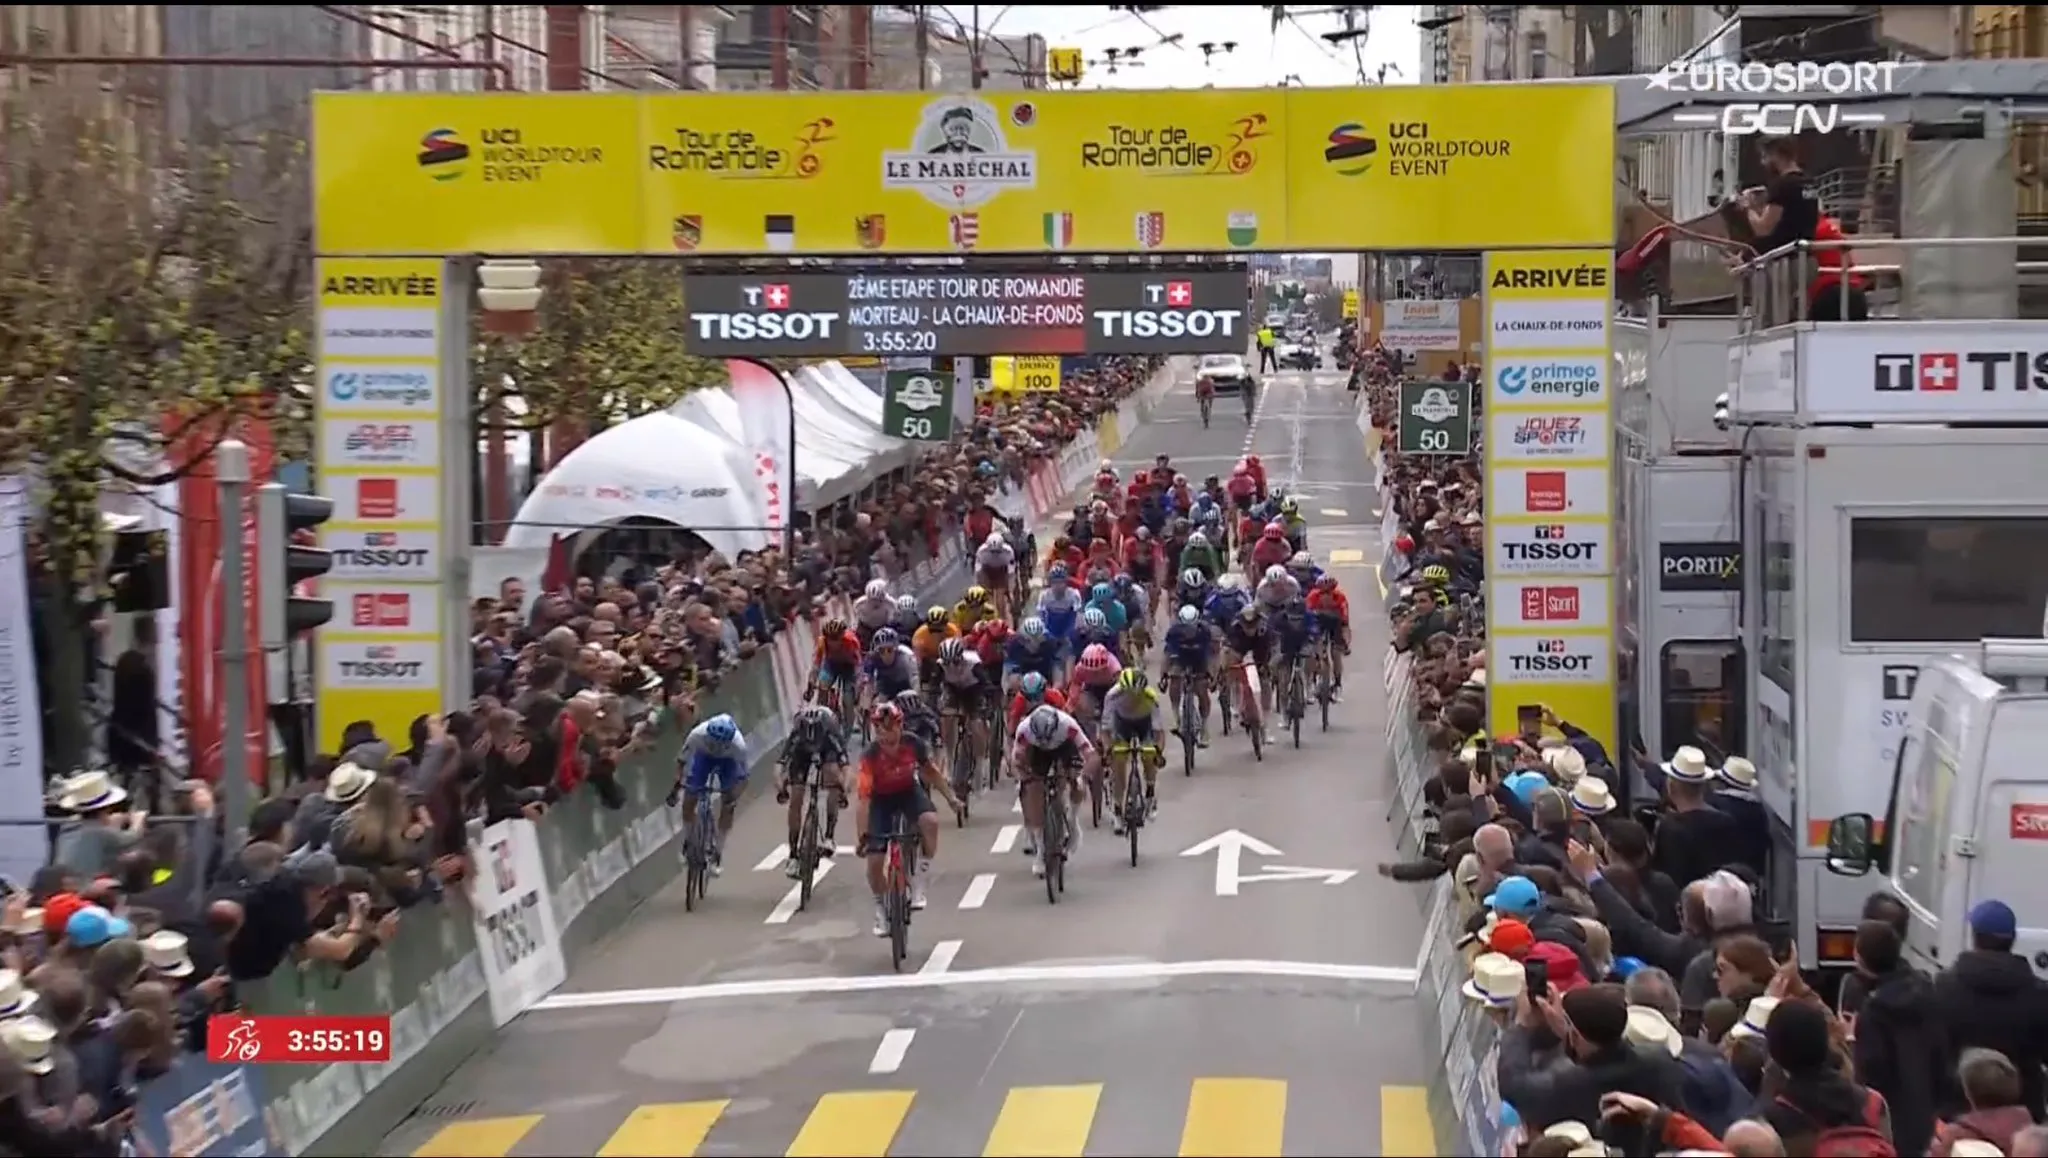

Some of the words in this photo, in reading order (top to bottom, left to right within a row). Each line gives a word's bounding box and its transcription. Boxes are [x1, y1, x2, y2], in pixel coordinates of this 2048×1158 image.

[481, 129, 520, 144] UCI
[675, 128, 721, 149] Tour
[726, 128, 755, 148] de
[1108, 125, 1153, 146] Tour
[1160, 125, 1187, 145] de
[1389, 122, 1428, 138] UCI
[483, 147, 603, 164] WORLDTOUR
[650, 144, 781, 172] Romandie
[1082, 142, 1213, 168] Romandie
[1389, 139, 1510, 158] WORLDTOUR
[484, 165, 542, 182] EVENT
[887, 161, 910, 178] LE
[918, 158, 1031, 178] MARÉCHAL
[1390, 159, 1450, 176] EVENT
[322, 272, 437, 296] ARRIVÉE
[1492, 264, 1607, 289] ARRIVÉE
[848, 274, 887, 299] 2ÈME
[891, 278, 936, 299] ETAPE
[938, 278, 978, 298] TOUR
[981, 278, 1001, 298] DE
[1004, 277, 1085, 298] ROMANDIE
[848, 305, 919, 325] MORTEAU
[932, 304, 951, 326] LA
[954, 302, 1085, 325] CHAUX-DE-FONDS
[1093, 309, 1242, 338] TISSOT
[690, 311, 840, 340] TISSOT
[1495, 321, 1508, 332] LA
[1511, 319, 1604, 332] CHAUX-DE-FONDS
[862, 331, 937, 352] 3:55:20
[1025, 374, 1053, 389] 100
[1531, 363, 1597, 382] primeo
[1531, 379, 1600, 398] energie
[902, 416, 932, 438] 50
[1525, 416, 1582, 430] JOUEZ
[1420, 428, 1449, 450] 50
[1514, 427, 1586, 445] SPORT!
[332, 549, 429, 566] TISSOT
[1502, 542, 1598, 560] TISSOT
[1663, 555, 1740, 578] PORTIX
[1526, 589, 1540, 618] RTS
[1548, 596, 1577, 613] Sport
[338, 661, 423, 677] TISSOT
[1509, 655, 1593, 671] TISSOT
